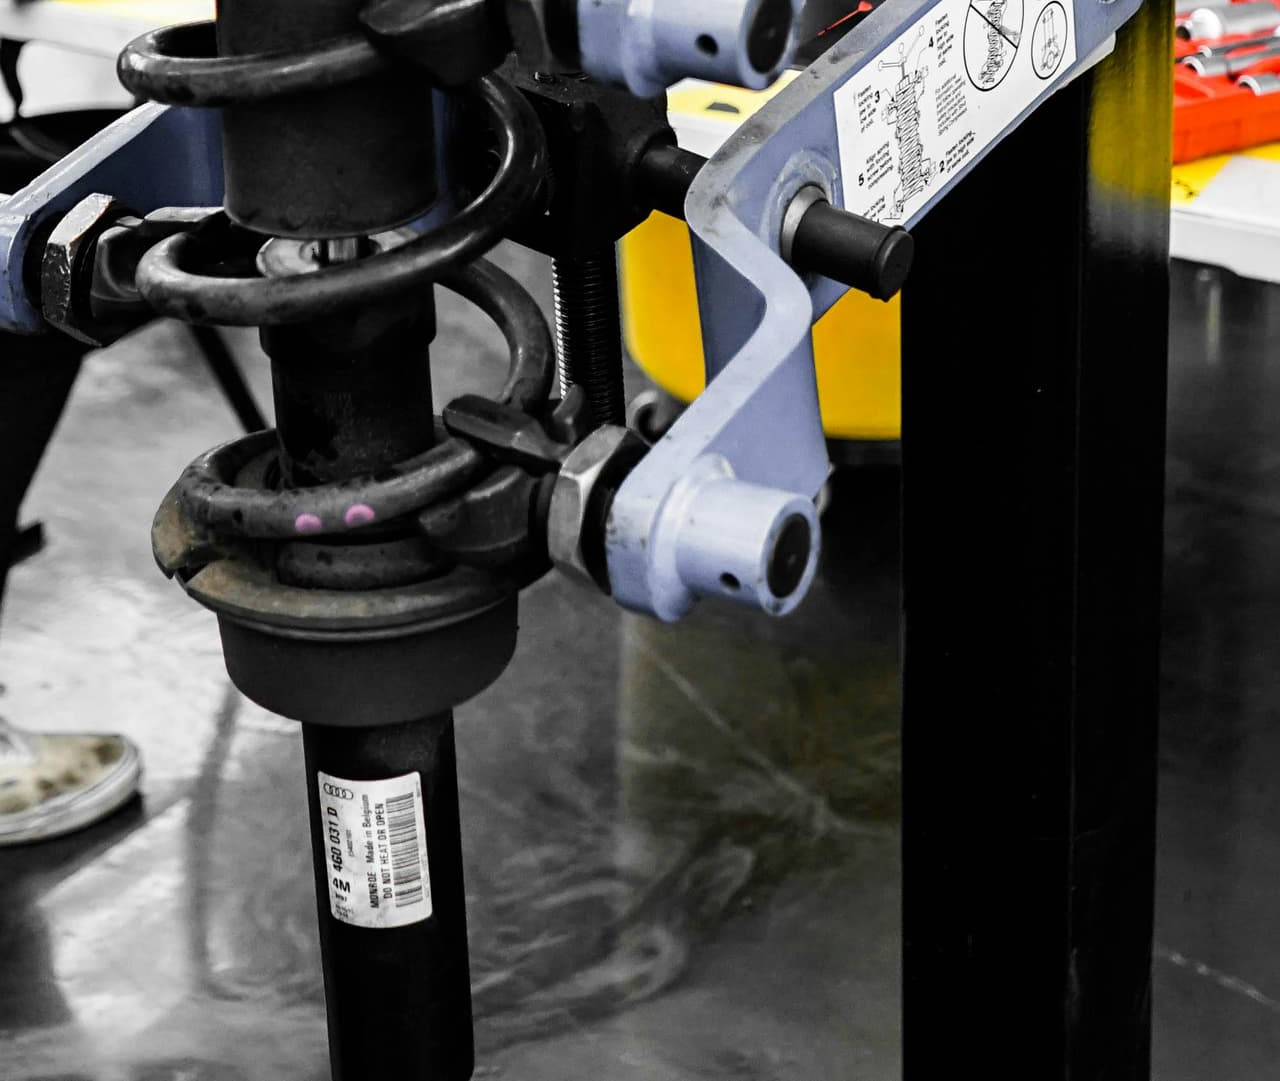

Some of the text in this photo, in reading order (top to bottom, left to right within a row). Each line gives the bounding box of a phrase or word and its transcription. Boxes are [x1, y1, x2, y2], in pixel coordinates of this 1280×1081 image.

[928, 36, 934, 48] 4
[873, 90, 881, 103] 3
[939, 160, 945, 174] 2
[858, 173, 865, 187] 5
[362, 794, 374, 828] Belgium
[365, 839, 375, 864] Made
[375, 803, 393, 900] DO NOT HEAT OR OPEN
[366, 871, 380, 909] MONROE
